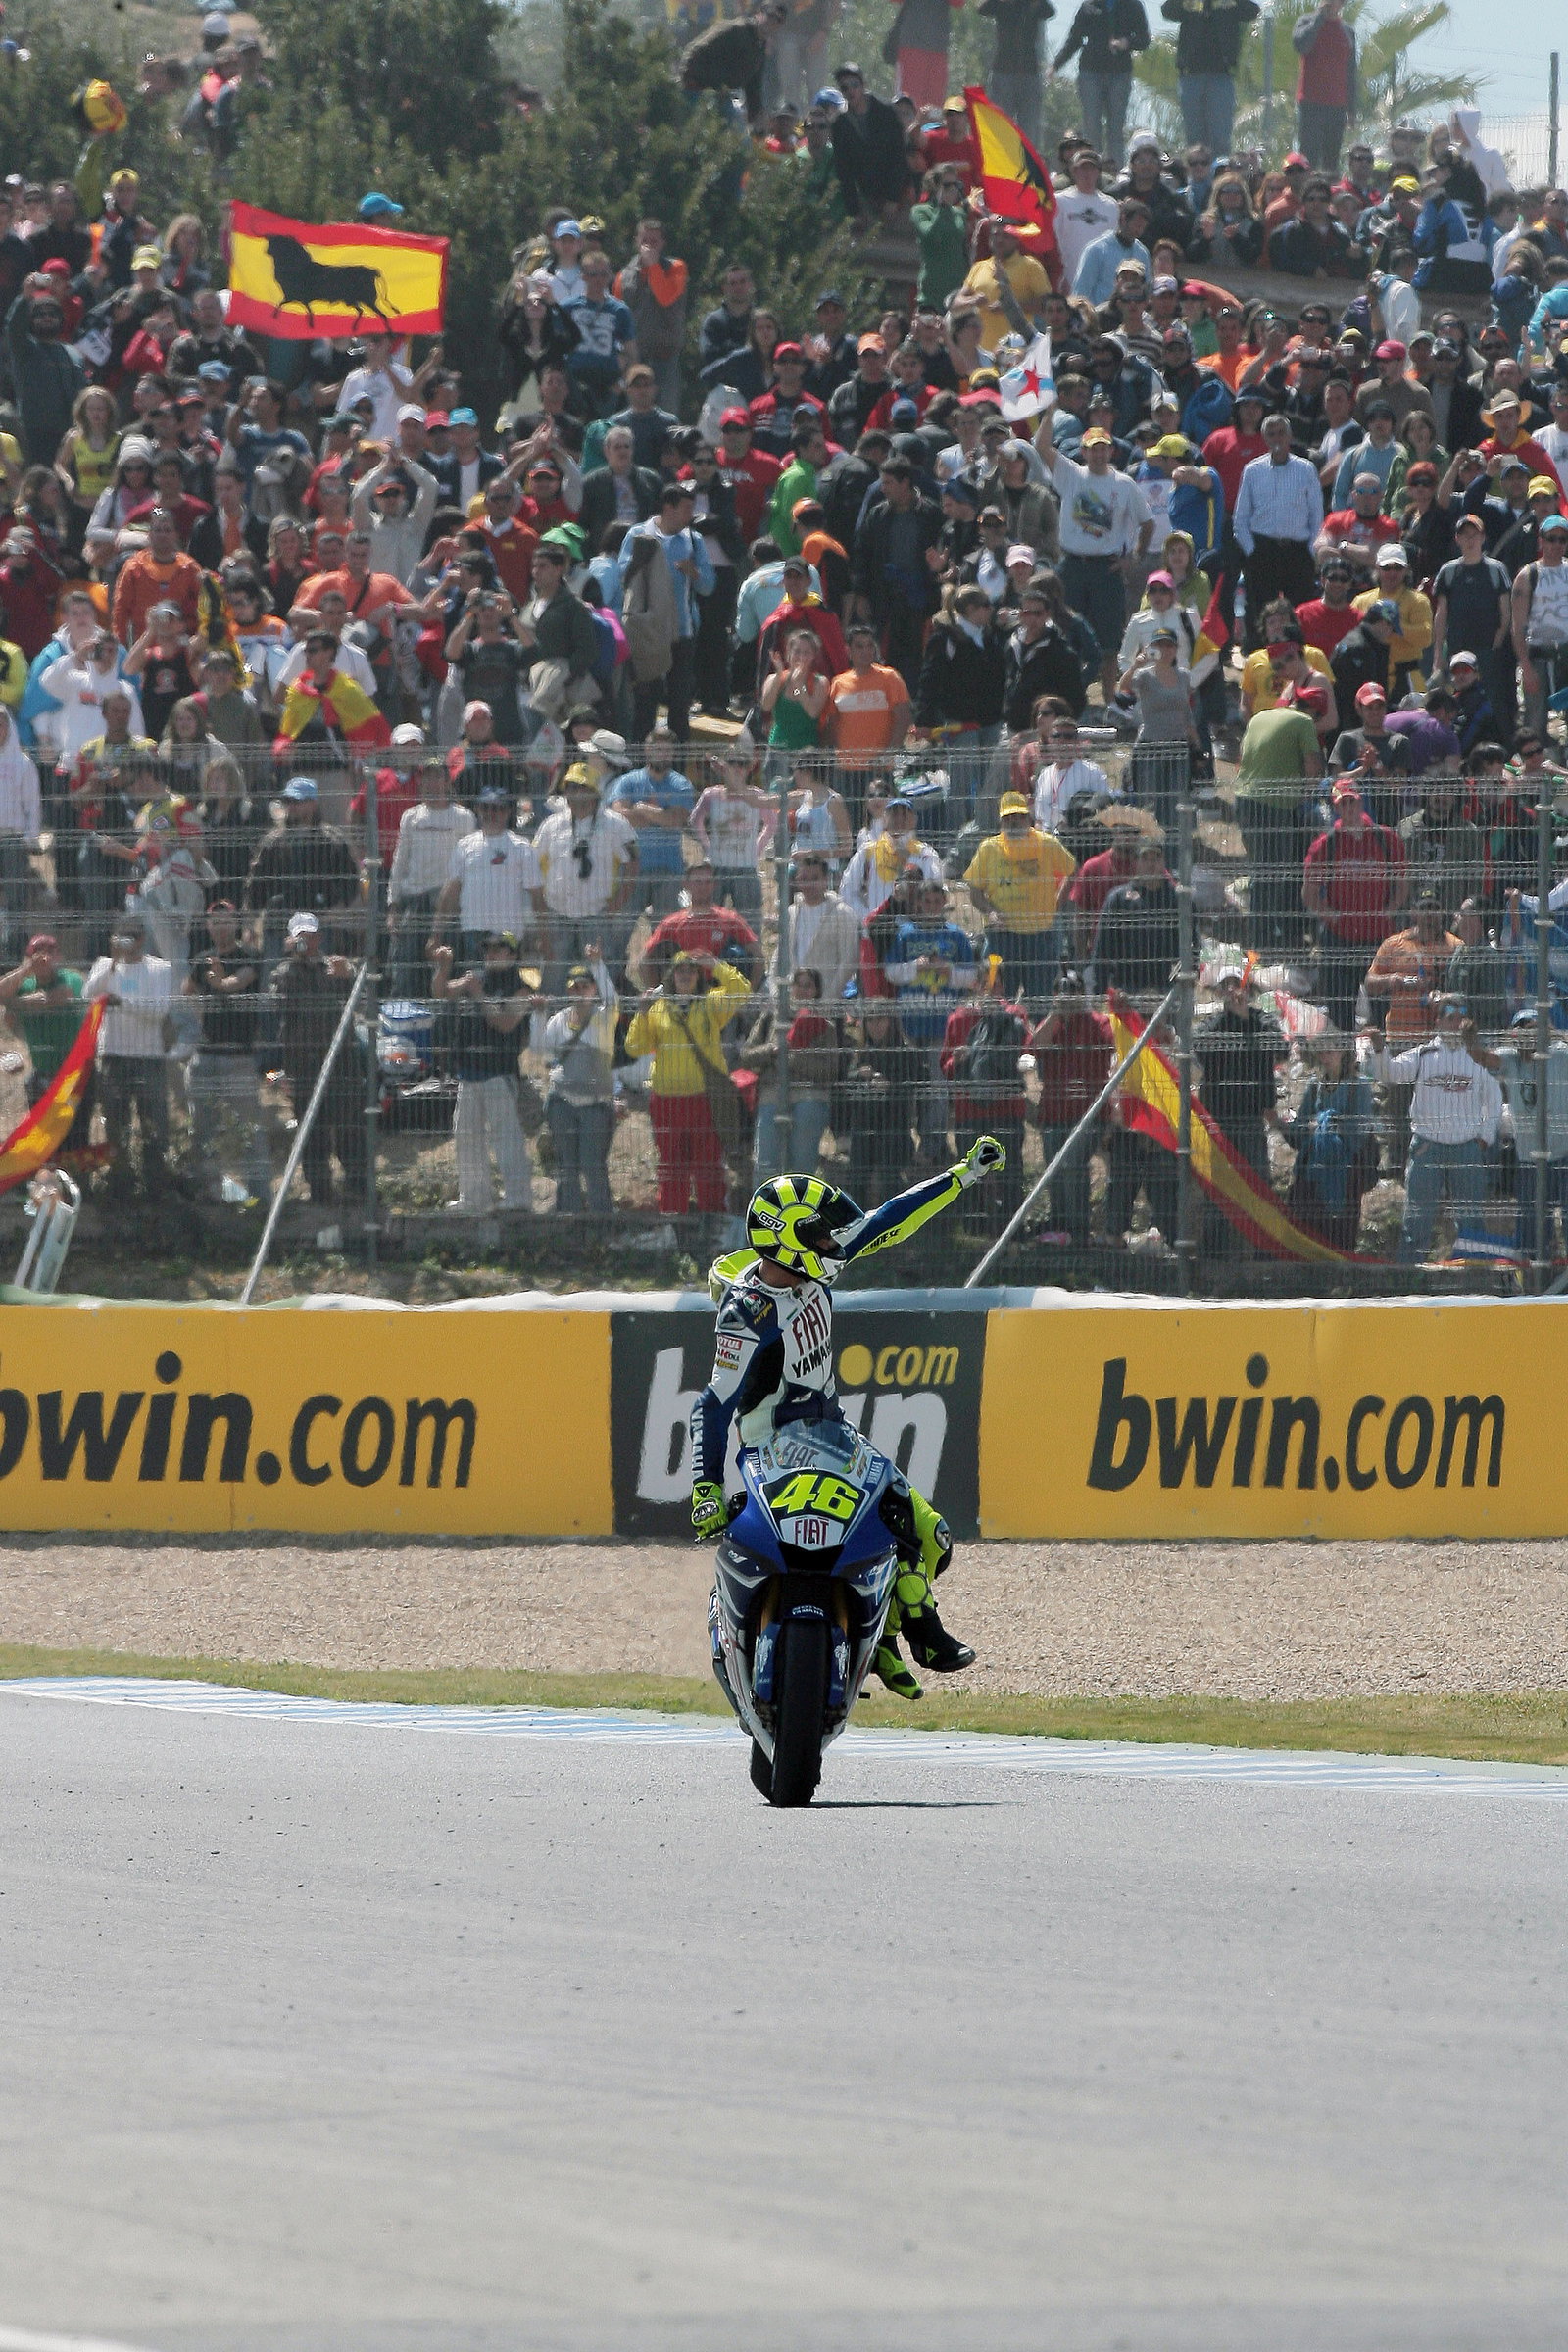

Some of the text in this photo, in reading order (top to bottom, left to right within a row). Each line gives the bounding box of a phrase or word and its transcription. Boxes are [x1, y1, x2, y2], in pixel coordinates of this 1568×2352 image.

[760, 1213, 784, 1231] agv
[718, 1335, 741, 1349] OTUL
[791, 1294, 829, 1357] FIAT
[1086, 1351, 1505, 1492] bwin.com
[769, 1473, 859, 1520] 46
[794, 1518, 830, 1545] FIAT
